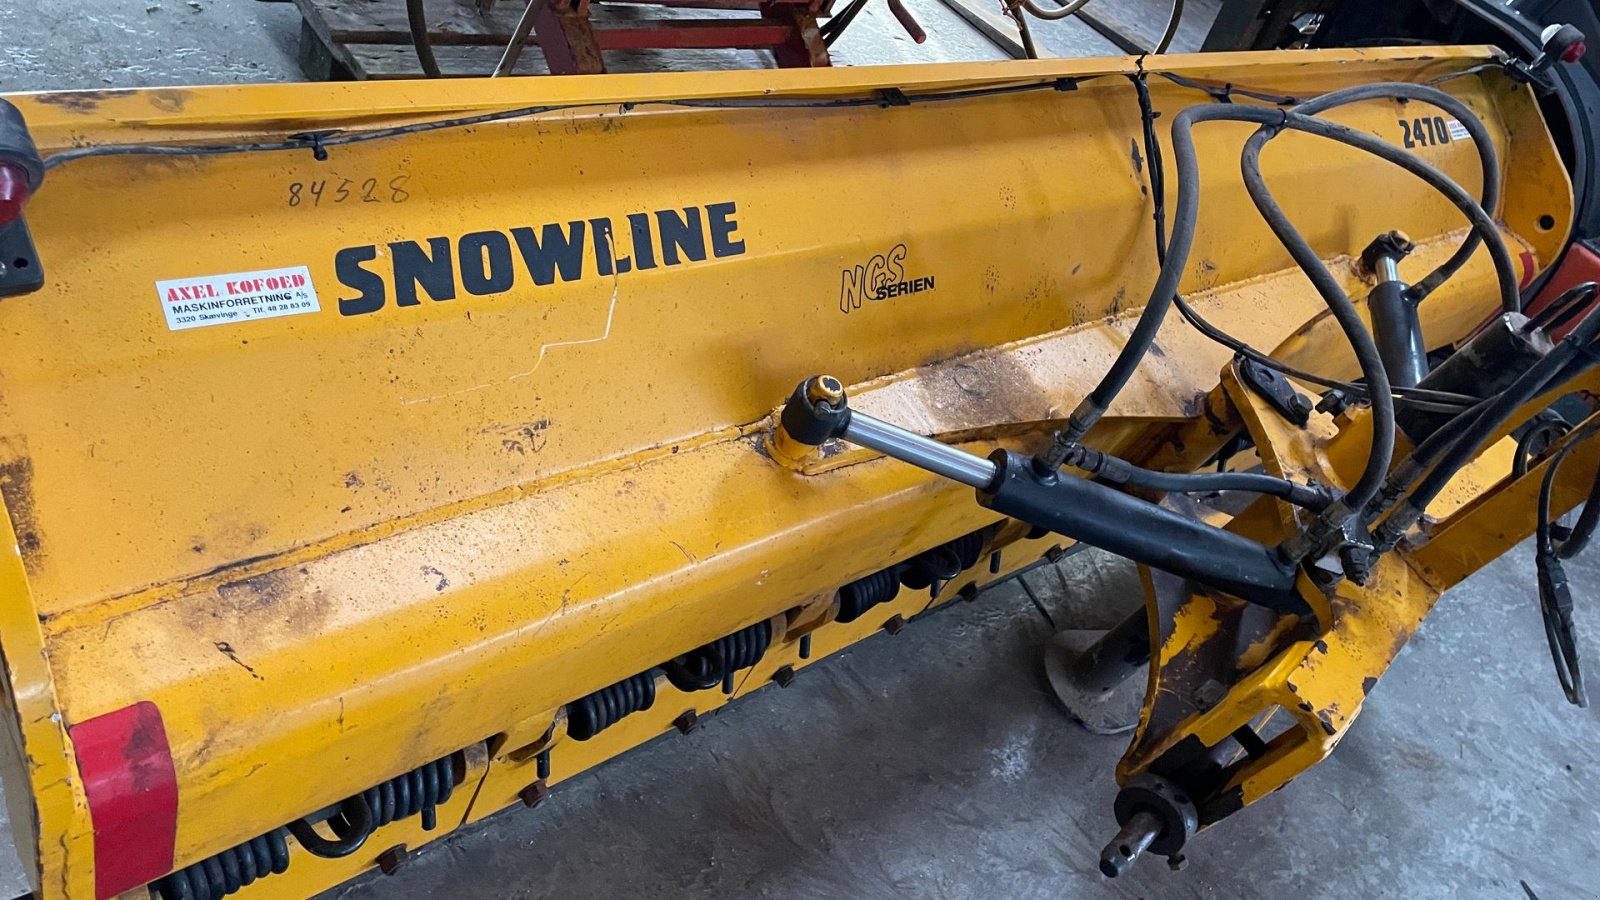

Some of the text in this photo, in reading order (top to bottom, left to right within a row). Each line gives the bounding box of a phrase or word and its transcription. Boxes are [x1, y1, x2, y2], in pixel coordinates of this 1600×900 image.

[1398, 116, 1449, 148] 2470
[334, 201, 746, 317] SNOWLINE
[167, 274, 306, 302] AXEL KOFOED
[840, 243, 907, 314] NGS
[876, 275, 935, 301] SERIEN
[172, 292, 293, 314] MASKINFORRETNING
[176, 315, 197, 324] 3320
[199, 310, 238, 321] Skævinge
[290, 302, 300, 310] 83
